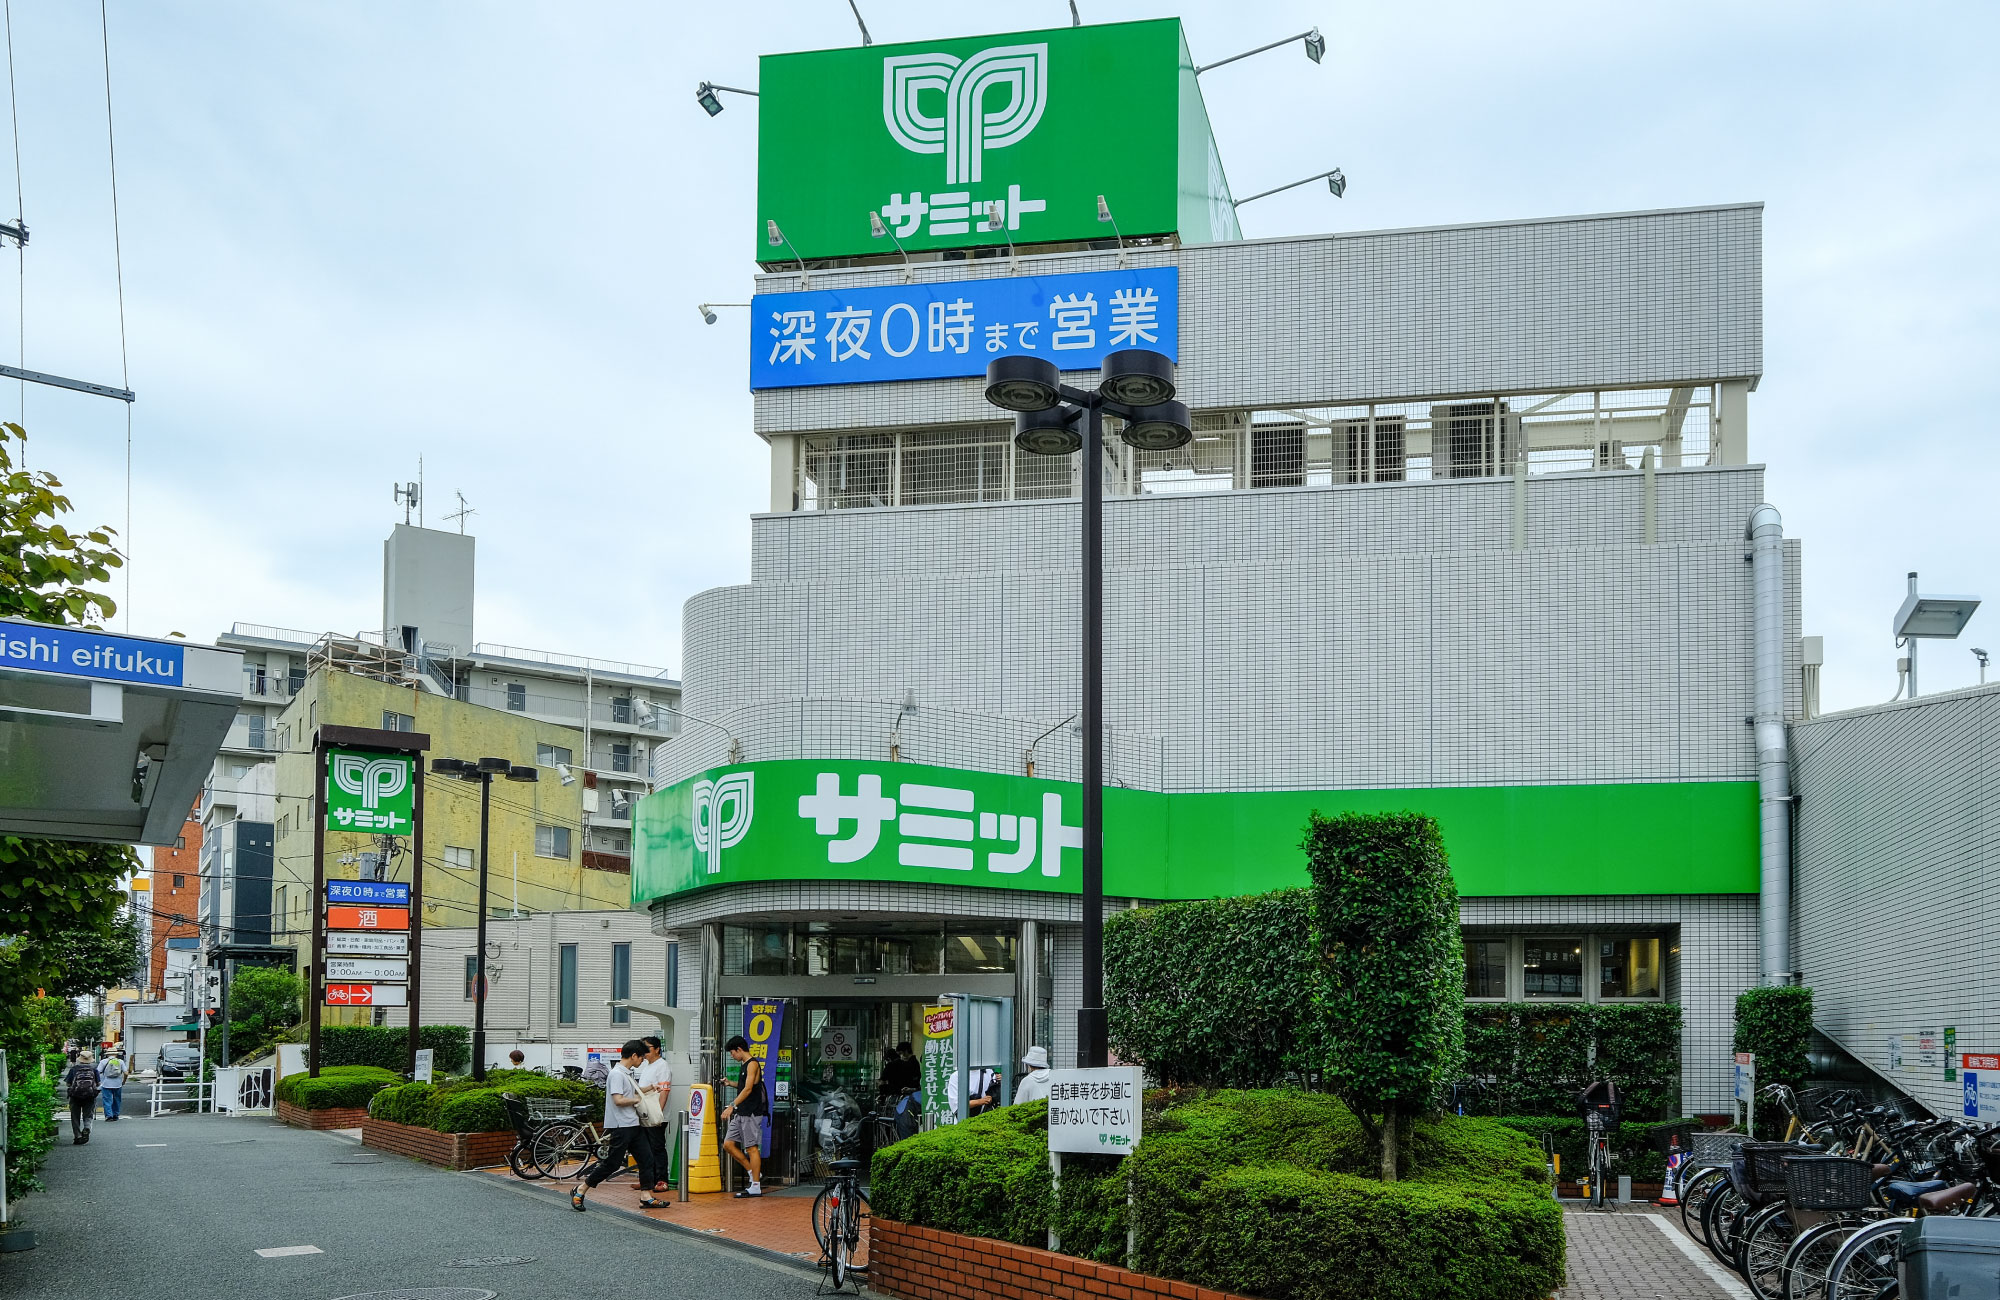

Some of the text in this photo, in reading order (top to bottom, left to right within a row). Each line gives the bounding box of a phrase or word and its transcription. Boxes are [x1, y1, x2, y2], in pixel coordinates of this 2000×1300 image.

[881, 184, 1047, 239] サミット
[768, 287, 1159, 367] 深夜0時まで営業
[71, 645, 175, 677] eifuku
[333, 807, 406, 830] サミット
[797, 771, 1084, 878] サミット
[329, 885, 407, 899] 深夜0時まで営業
[358, 910, 378, 927] 酒
[330, 968, 362, 976] 9:00AM
[374, 969, 405, 977] 0:00AM
[925, 1009, 954, 1024] パート・アルバイ
[1050, 1081, 1132, 1101] 自転車等を歩道に
[1050, 1107, 1131, 1126] 置かないで下さい
[1109, 1134, 1131, 1146] サミット
